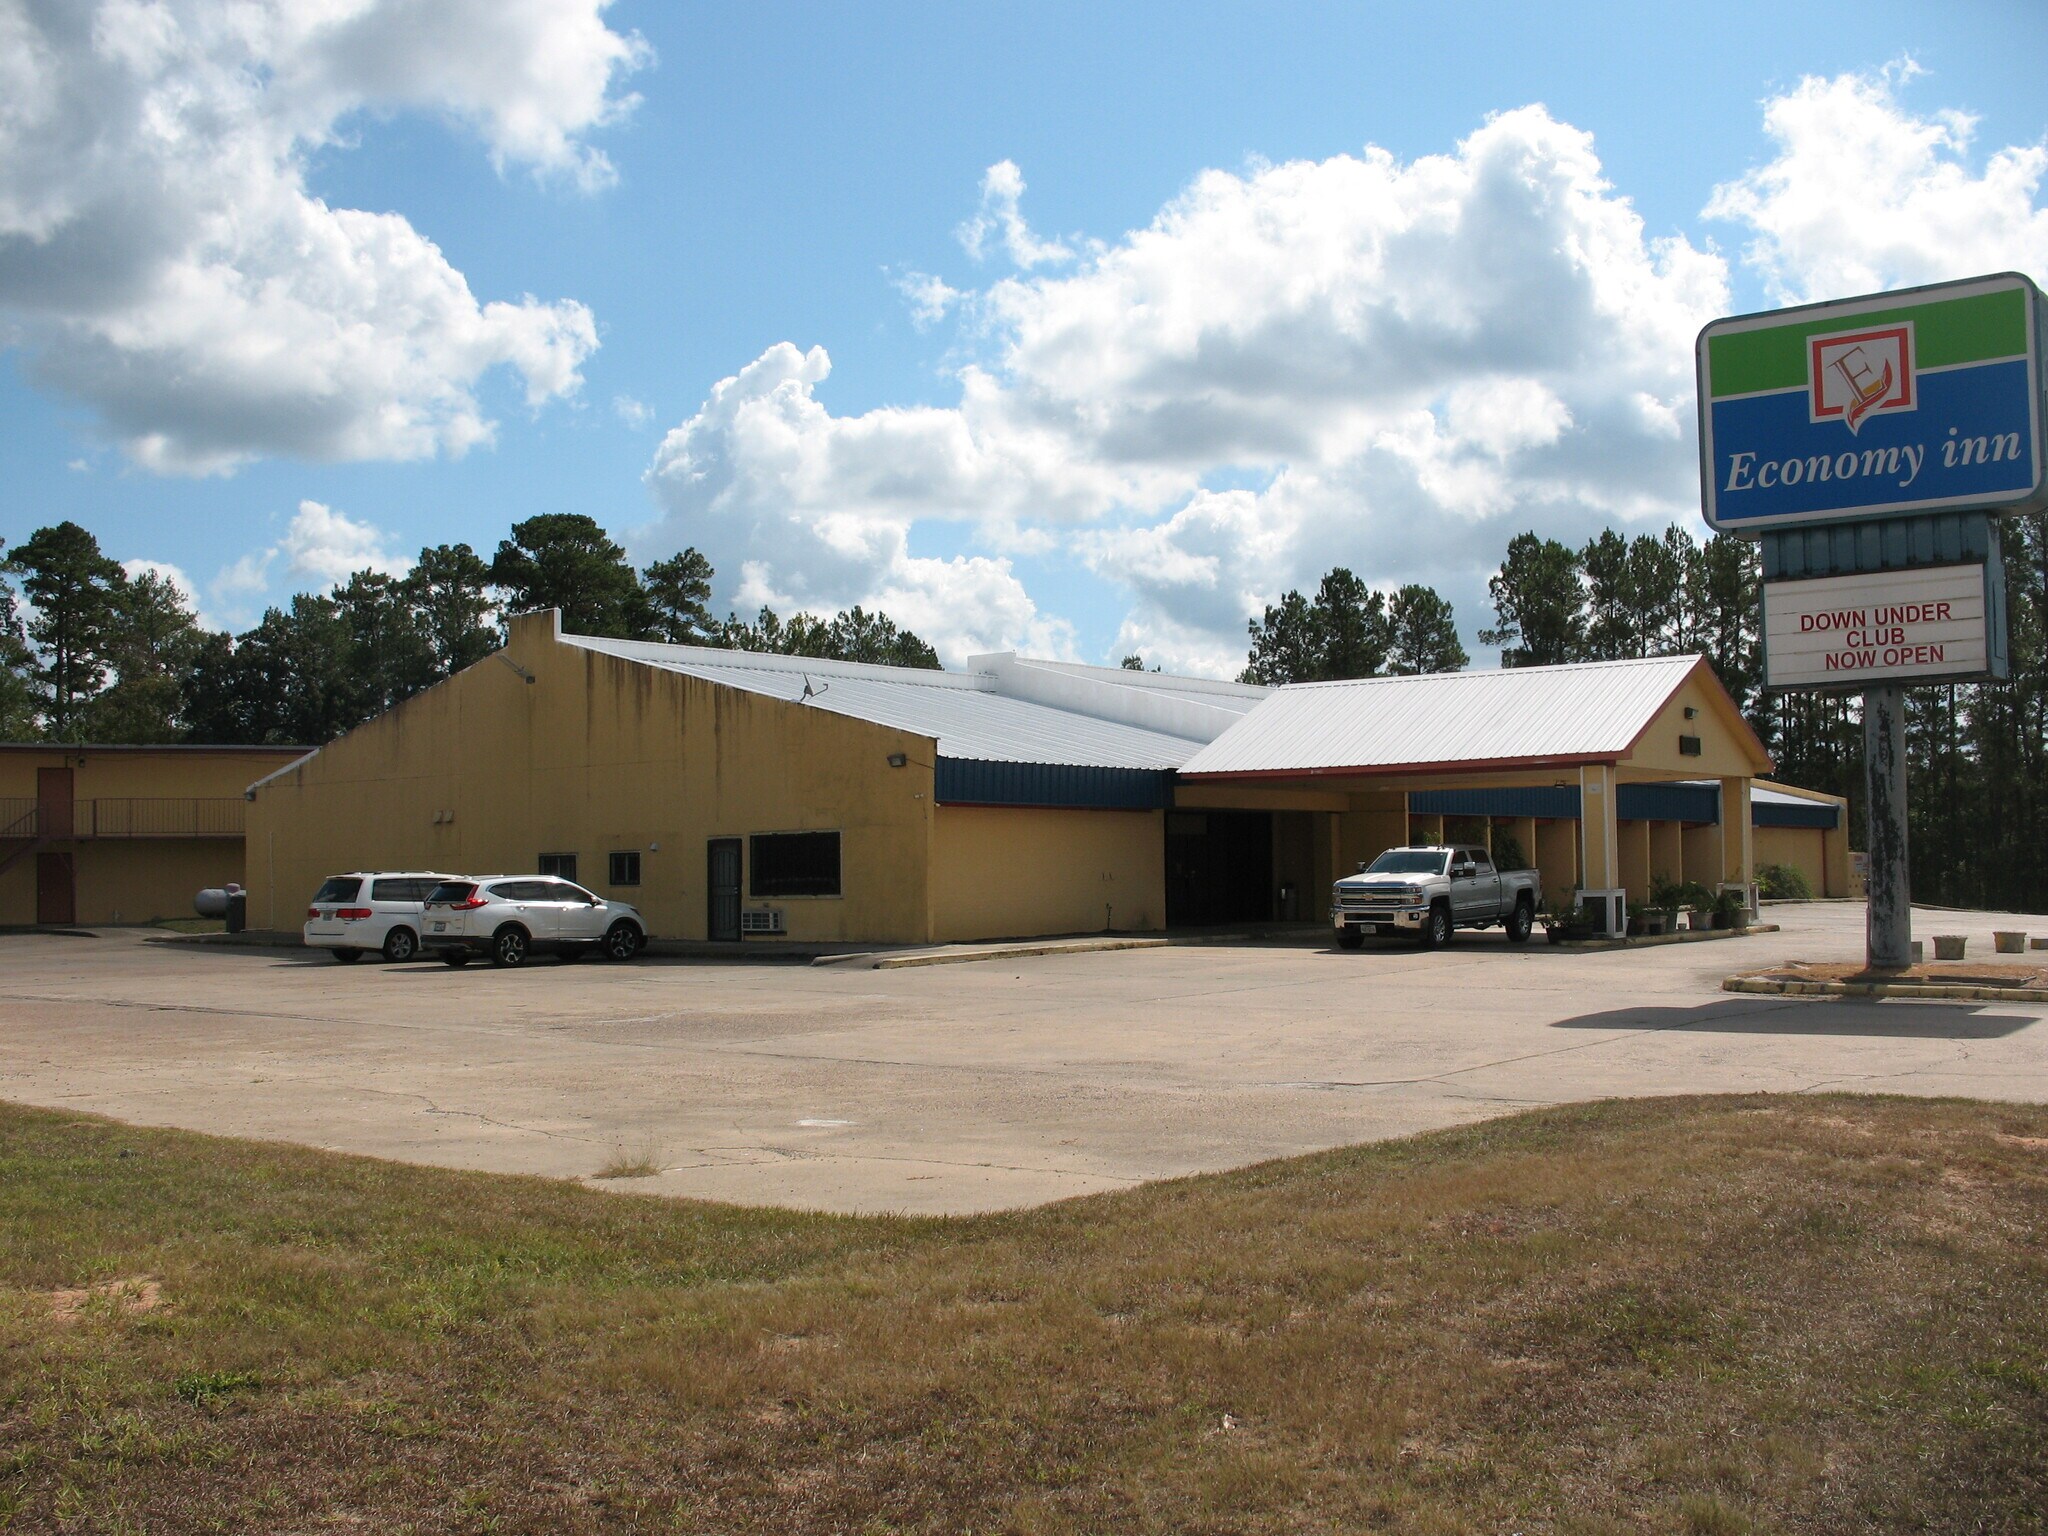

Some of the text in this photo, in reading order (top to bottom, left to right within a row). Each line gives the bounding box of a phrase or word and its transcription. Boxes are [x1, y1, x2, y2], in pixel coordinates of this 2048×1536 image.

[1723, 427, 2021, 492] Economy inn
[1801, 602, 1952, 632] DOWN UNDER
[1846, 627, 1905, 648] CLUB
[1826, 645, 1944, 670] NOW OPEN
